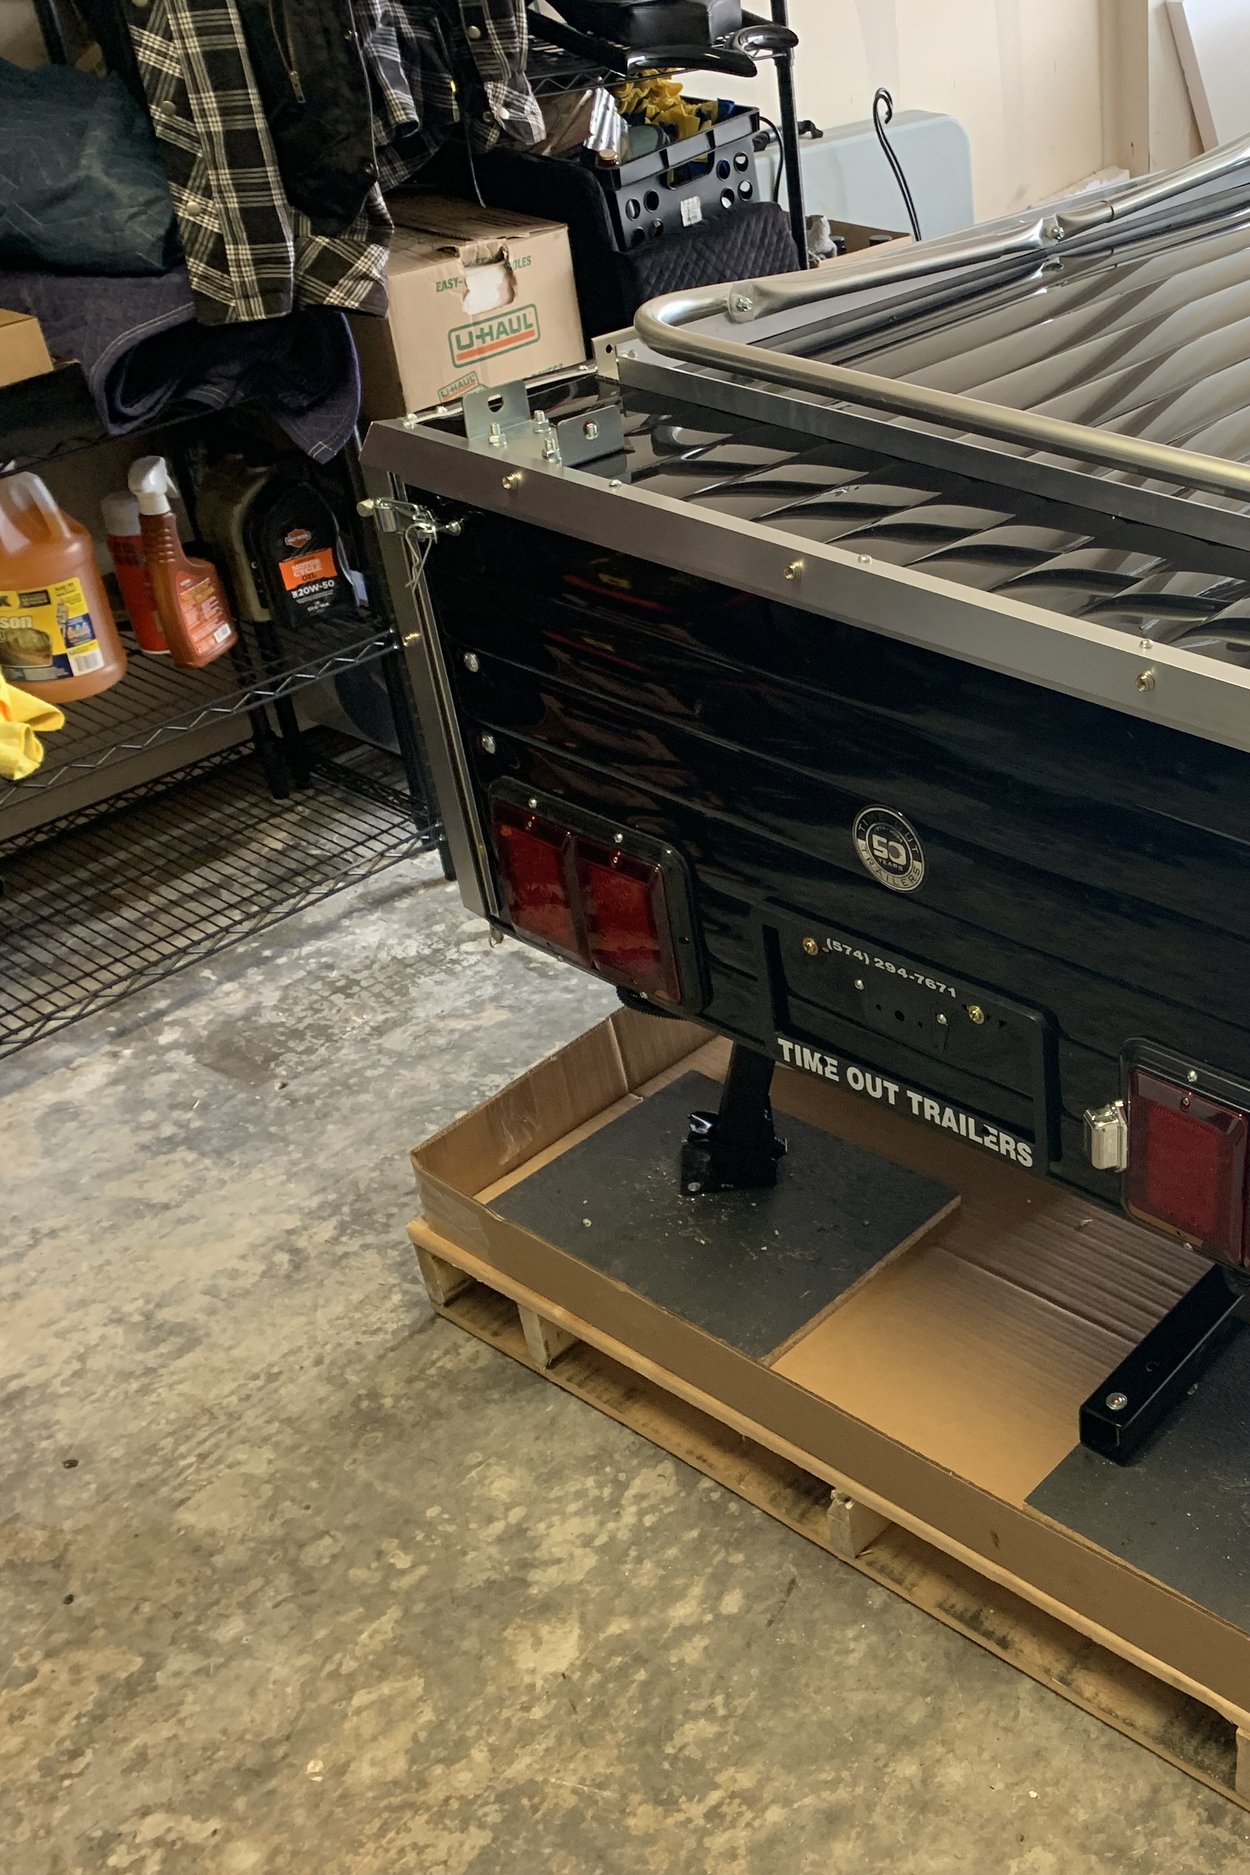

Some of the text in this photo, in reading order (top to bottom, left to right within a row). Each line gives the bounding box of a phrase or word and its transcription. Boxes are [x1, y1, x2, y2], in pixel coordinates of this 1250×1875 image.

[455, 313, 534, 351] U-HAUL
[440, 374, 477, 398] U-HAUL
[297, 580, 335, 597] 20W-50
[0, 616, 32, 628] son
[861, 847, 921, 887] TRAILERS
[872, 833, 907, 866] 50
[826, 937, 958, 999] (574) 294-7671
[777, 1038, 1034, 1168] TIME OUT TRAILERS
